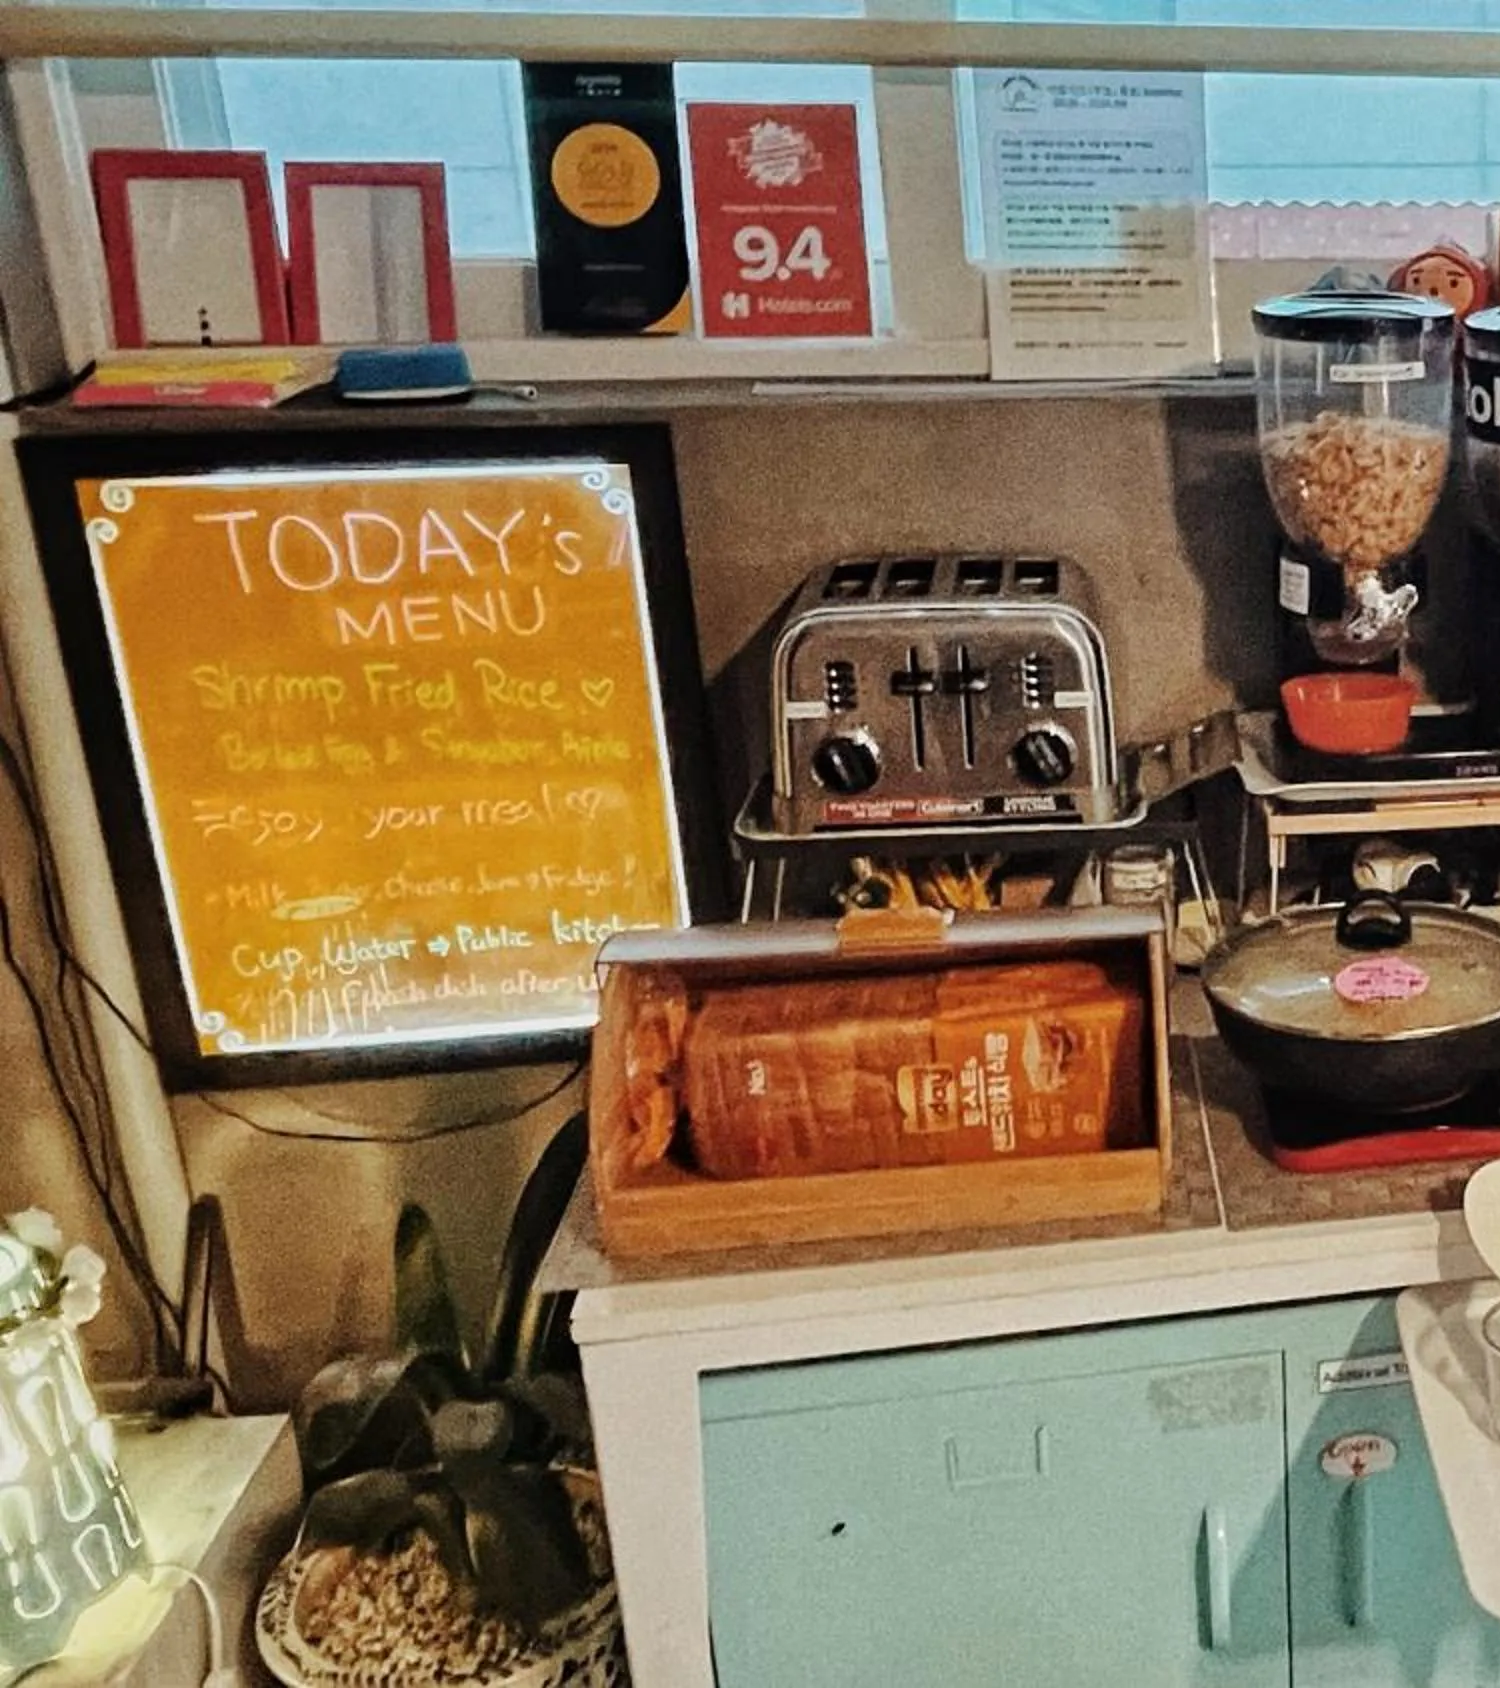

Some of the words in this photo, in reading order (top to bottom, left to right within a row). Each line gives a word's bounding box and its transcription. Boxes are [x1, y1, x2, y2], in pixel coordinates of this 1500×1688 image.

[732, 224, 832, 281] 9.4
[193, 507, 583, 594] TODAY's
[335, 584, 546, 646] MENU
[190, 664, 346, 722] Shrimp
[363, 663, 458, 711] Fried
[473, 657, 563, 710] Rice
[364, 801, 443, 840] your
[455, 924, 534, 957] Public
[551, 908, 661, 946] kitch
